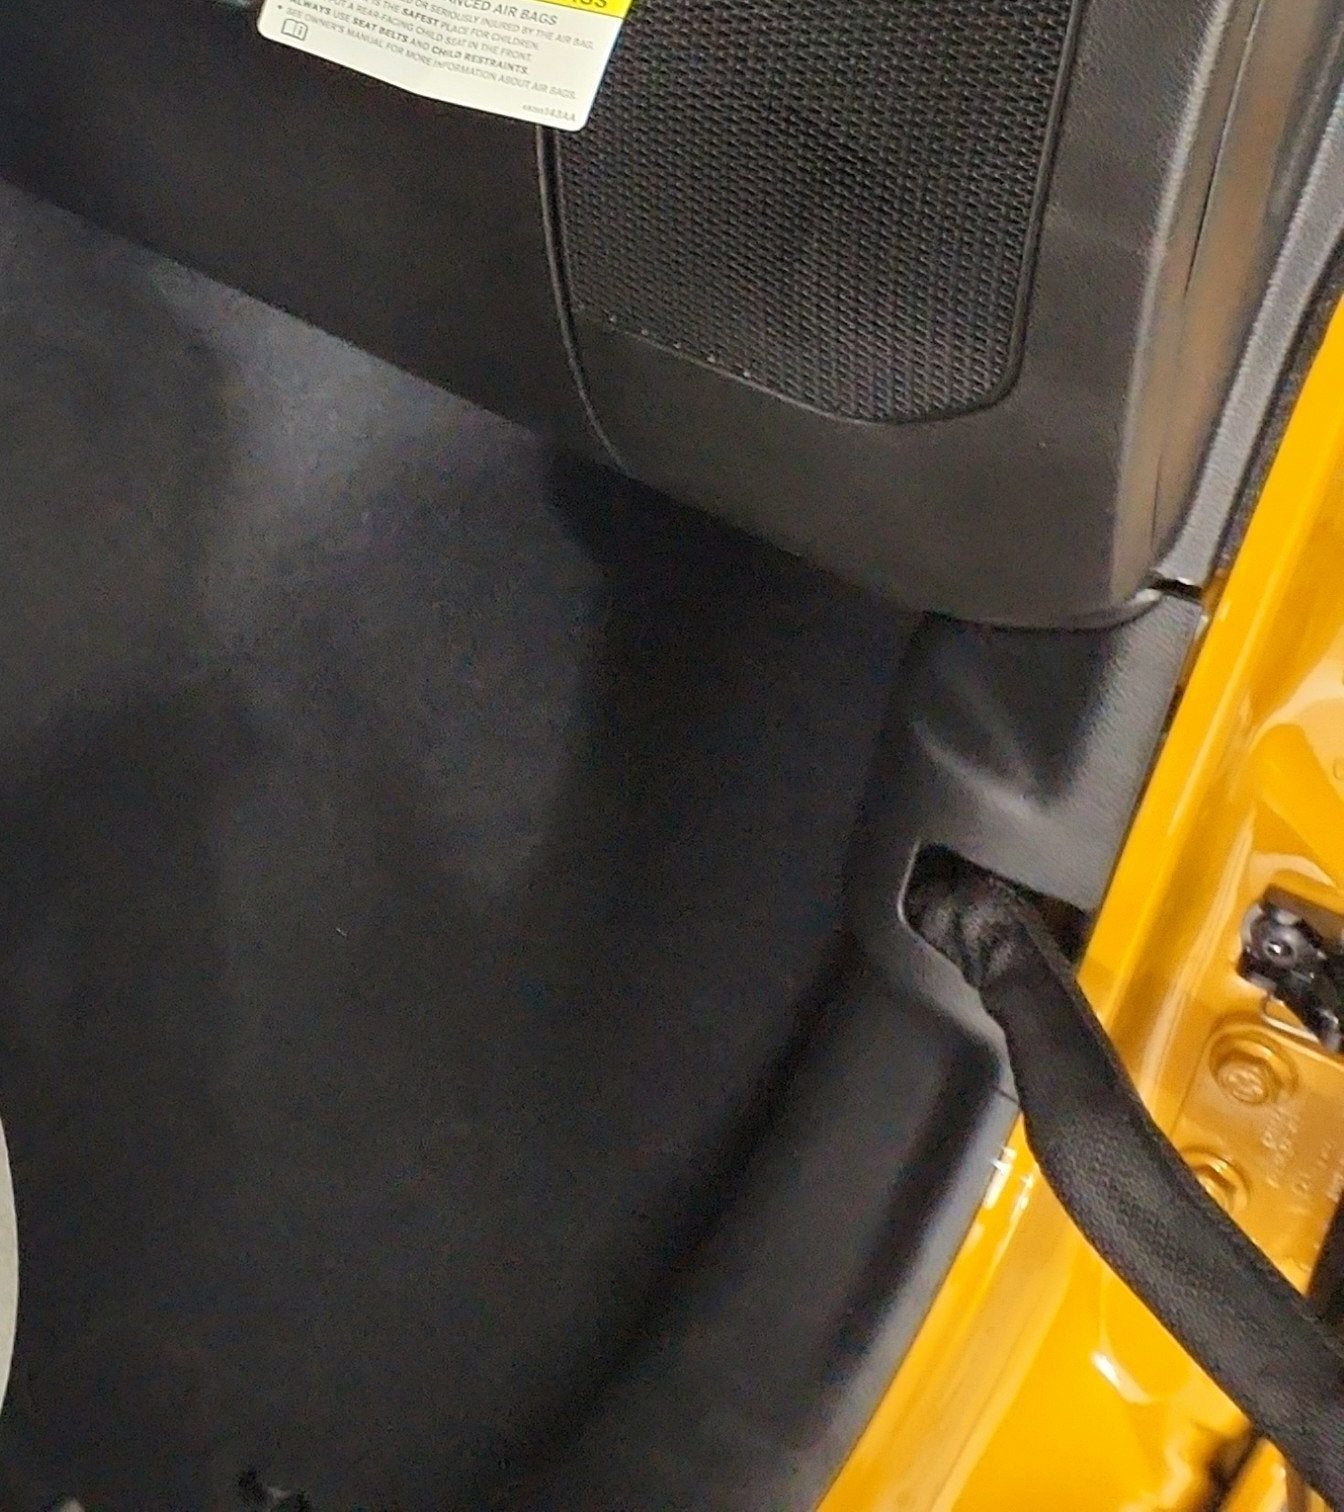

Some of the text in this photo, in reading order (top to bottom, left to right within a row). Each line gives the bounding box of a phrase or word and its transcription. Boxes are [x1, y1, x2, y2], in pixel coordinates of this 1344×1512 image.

[333, 10, 351, 23] USE
[352, 17, 377, 31] SEAT
[378, 26, 409, 43] BELTS
[409, 38, 430, 50] AND
[431, 46, 462, 59] CHILD
[383, 0, 400, 14] THE
[401, 8, 440, 26] SAFEST
[440, 22, 470, 35] PLACE
[470, 28, 490, 40] FOR
[415, 0, 429, 9] OR
[521, 26, 534, 35] BY
[536, 29, 554, 41] THE
[555, 34, 572, 45] AIR
[493, 4, 518, 17] AIR
[520, 8, 558, 25] BAGS
[415, 26, 444, 42] CHILD
[444, 36, 467, 47] SEAT
[467, 40, 479, 50] IN
[480, 42, 500, 55] THE
[386, 42, 404, 54] FOR
[497, 73, 532, 88] ABOUT
[531, 82, 548, 93] AIR
